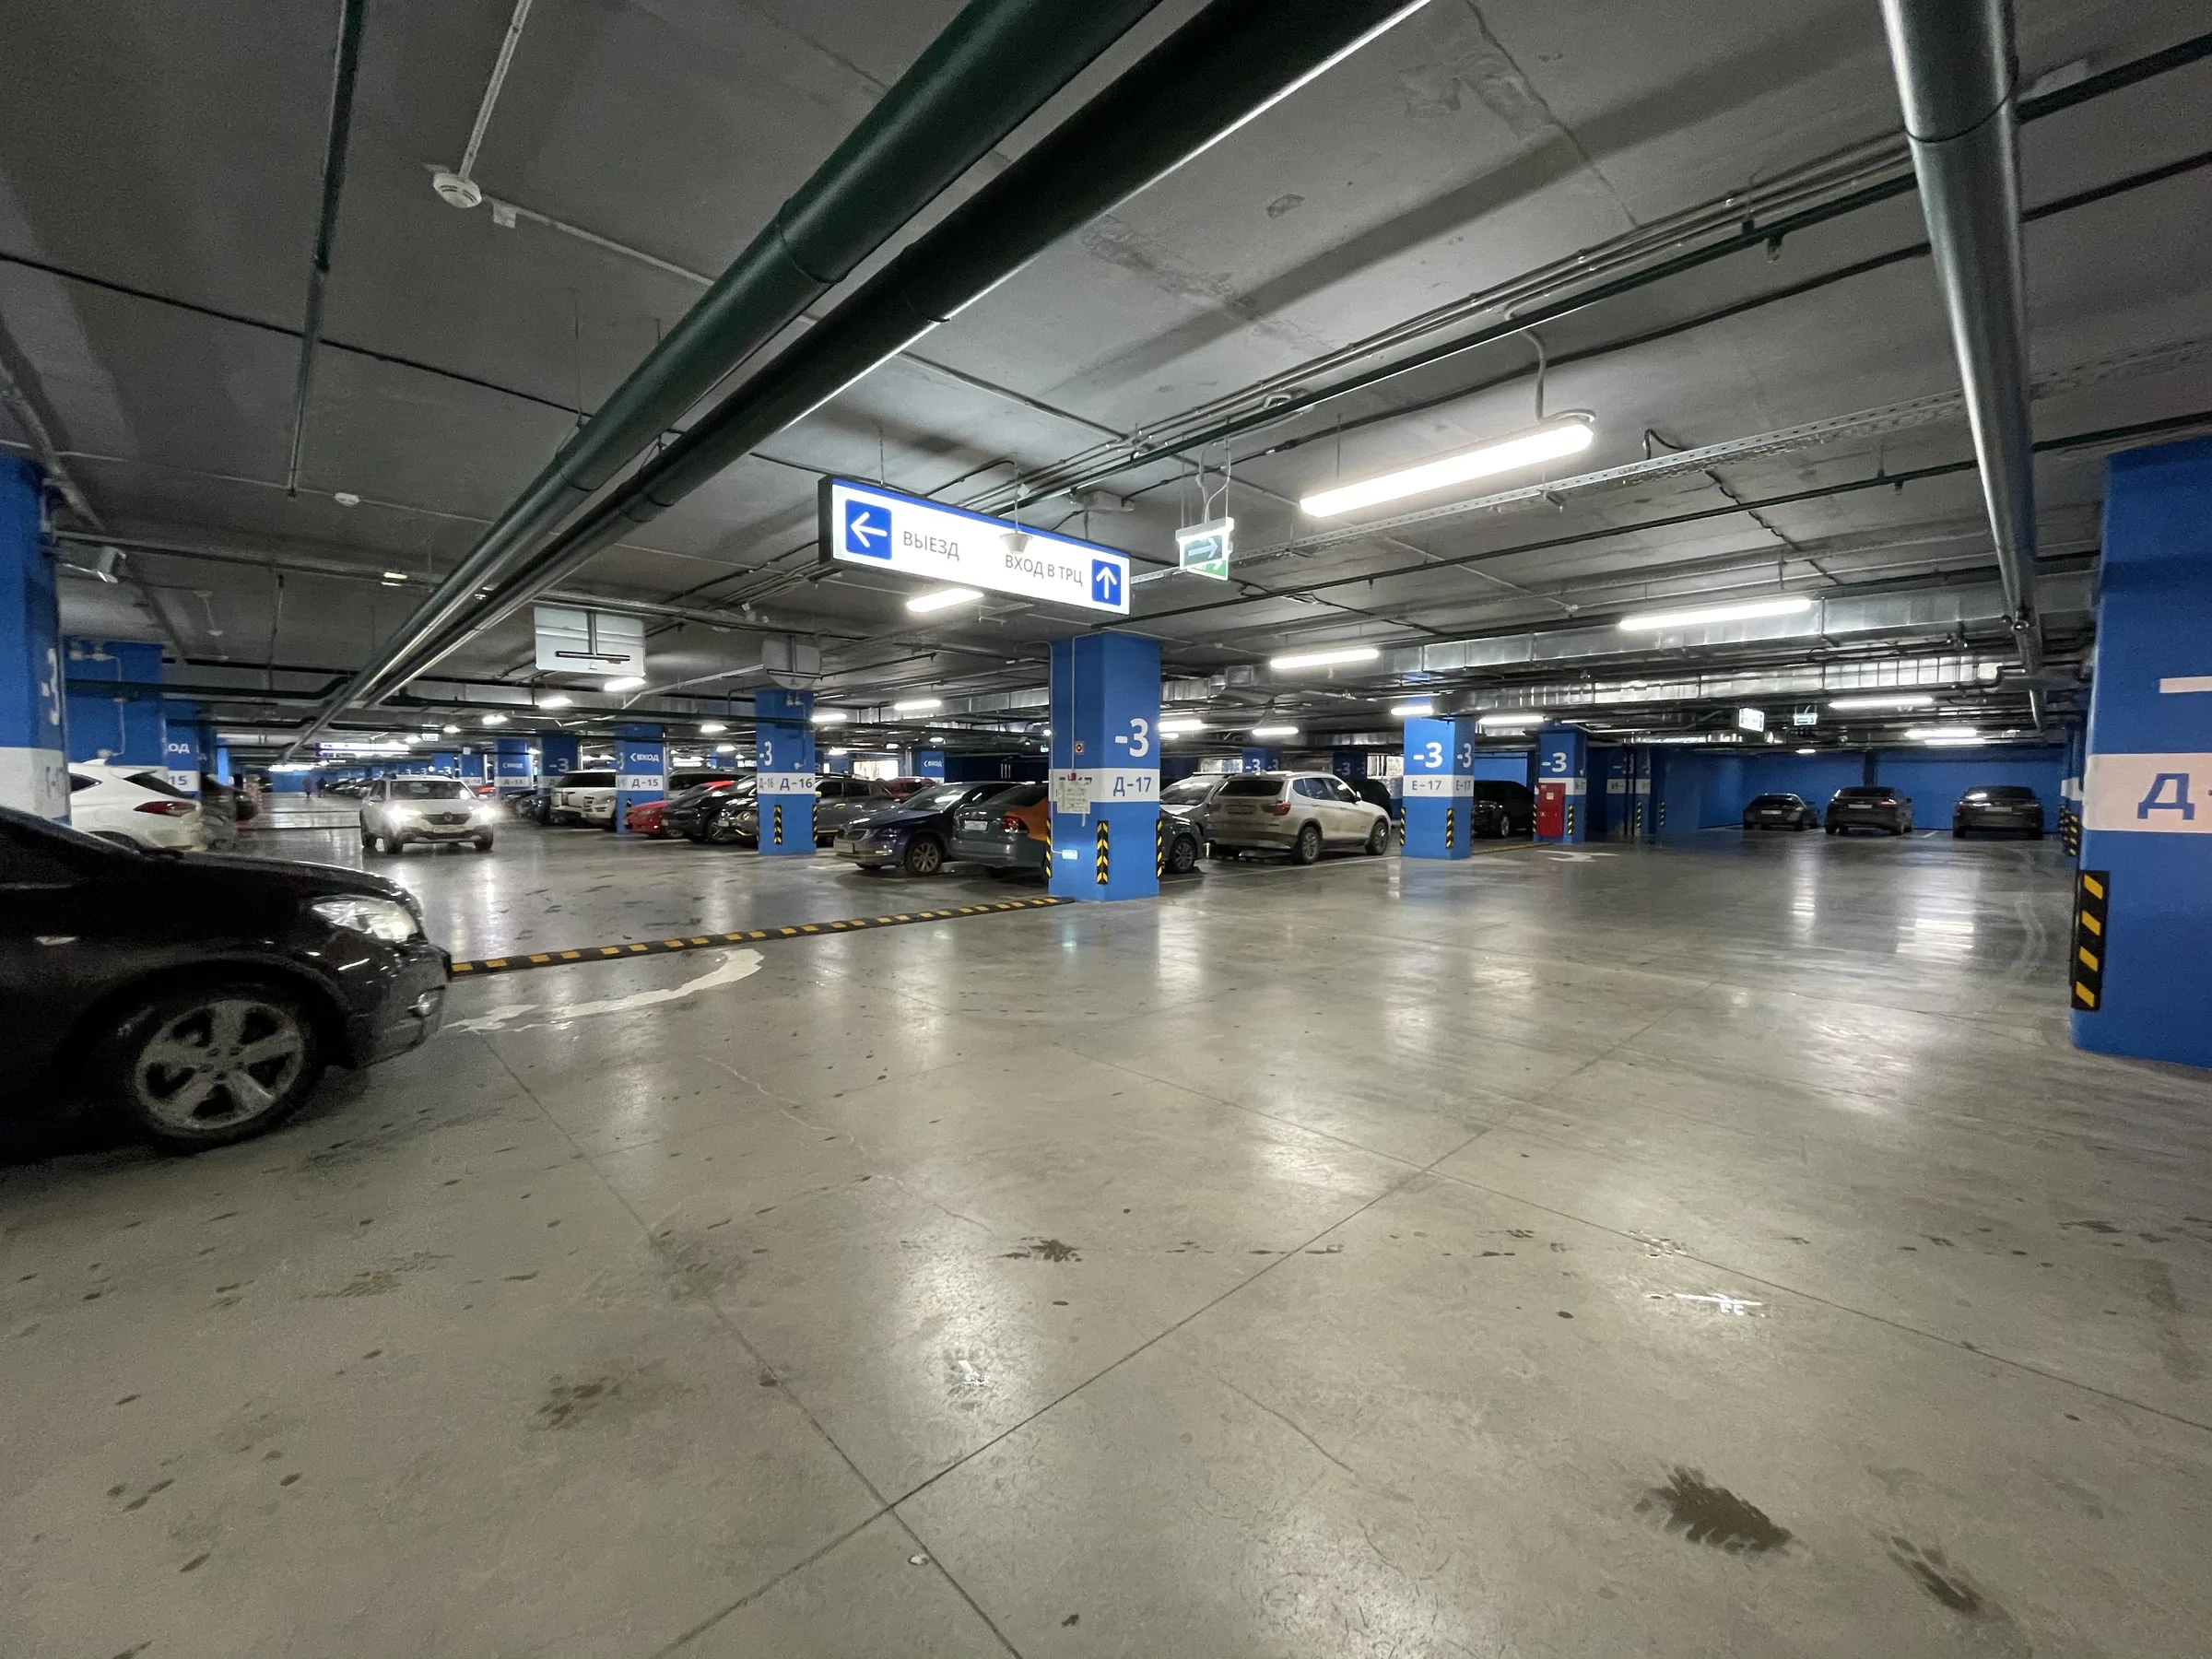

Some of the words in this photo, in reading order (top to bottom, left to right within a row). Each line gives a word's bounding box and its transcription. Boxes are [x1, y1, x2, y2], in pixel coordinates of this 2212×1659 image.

[903, 531, 959, 561] ВЫЕЗД
[1006, 554, 1044, 579] ВХОД
[1047, 563, 1055, 577] В
[1058, 566, 1083, 587] ТРЦ
[1115, 718, 1149, 757] -3
[759, 741, 772, 766] -3
[1413, 742, 1443, 768] -3
[1456, 743, 1472, 768] -3
[1541, 752, 1567, 772] -3
[549, 758, 570, 772] -3
[1245, 759, 1261, 772] -3
[631, 778, 659, 789] Д-15
[780, 778, 813, 791] Д-16
[1113, 776, 1152, 797] Д-17
[1412, 780, 1442, 791] Е-17
